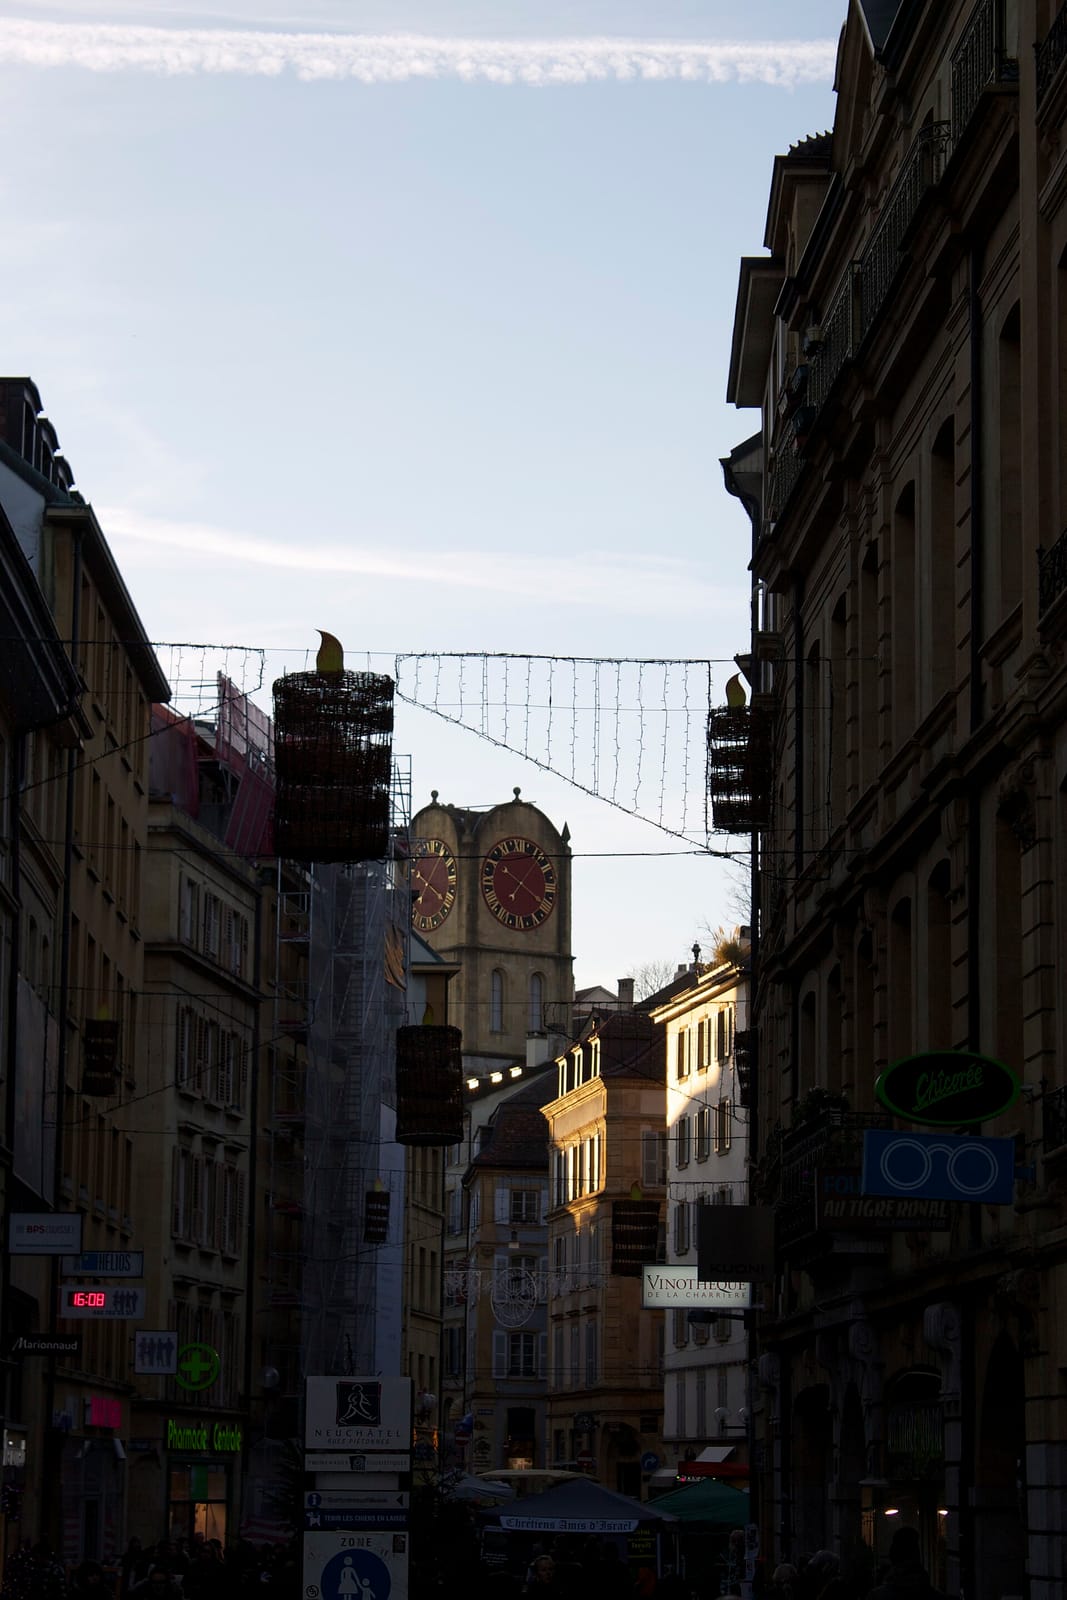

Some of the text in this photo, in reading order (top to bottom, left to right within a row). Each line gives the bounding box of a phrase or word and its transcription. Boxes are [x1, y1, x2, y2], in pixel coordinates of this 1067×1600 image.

[97, 1254, 131, 1272] HELIOS
[710, 1263, 764, 1274] KUONI
[73, 1292, 106, 1308] 16:08
[11, 1336, 78, 1352] Marionnaud
[167, 1419, 242, 1452] Pharmacie Centrale
[314, 1428, 400, 1438] NEUCHÂTEL
[559, 1519, 586, 1530] Amis
[340, 1537, 372, 1548] ZONE
